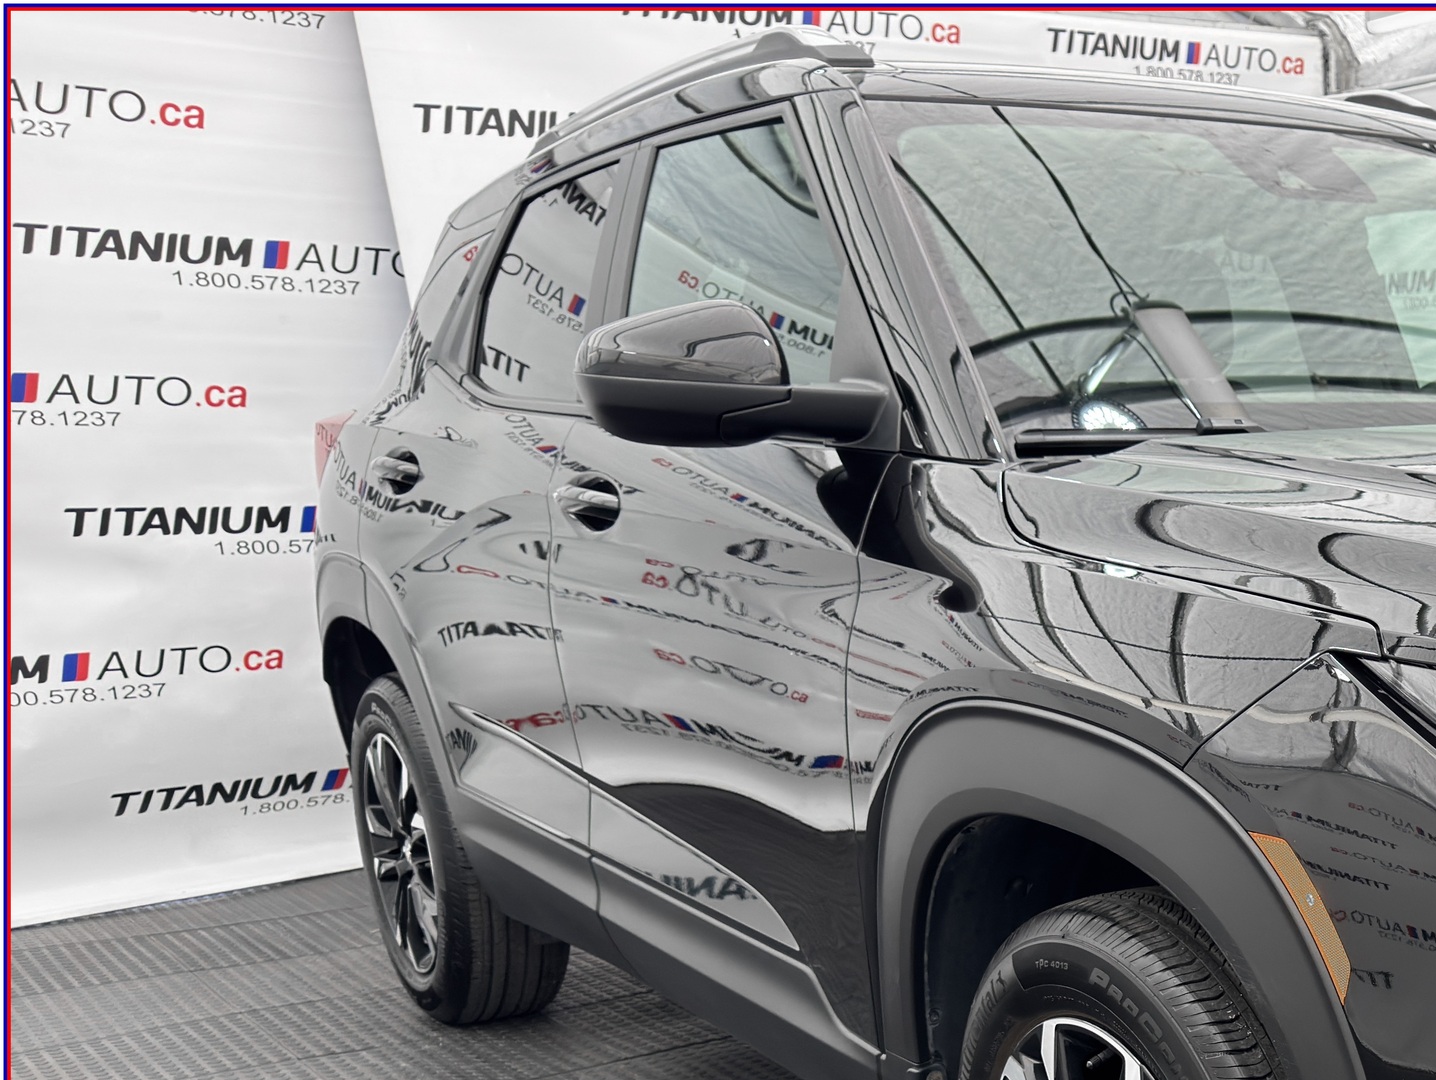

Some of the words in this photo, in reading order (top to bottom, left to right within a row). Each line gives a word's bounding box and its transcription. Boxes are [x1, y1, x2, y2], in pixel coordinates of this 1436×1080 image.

[827, 11, 961, 44] AUTO.ca
[1047, 27, 1181, 63] TITANIUM
[1204, 44, 1305, 76] AUTO.ca
[13, 222, 253, 267] TITANIUM
[172, 270, 360, 295] 1.800.578.1237
[46, 373, 248, 408] AUTO.ca
[64, 506, 292, 537] TITANIUM
[97, 645, 283, 681] AUTO.ca
[111, 771, 317, 816] TITANIUM
[1050, 960, 1069, 970] 4013
